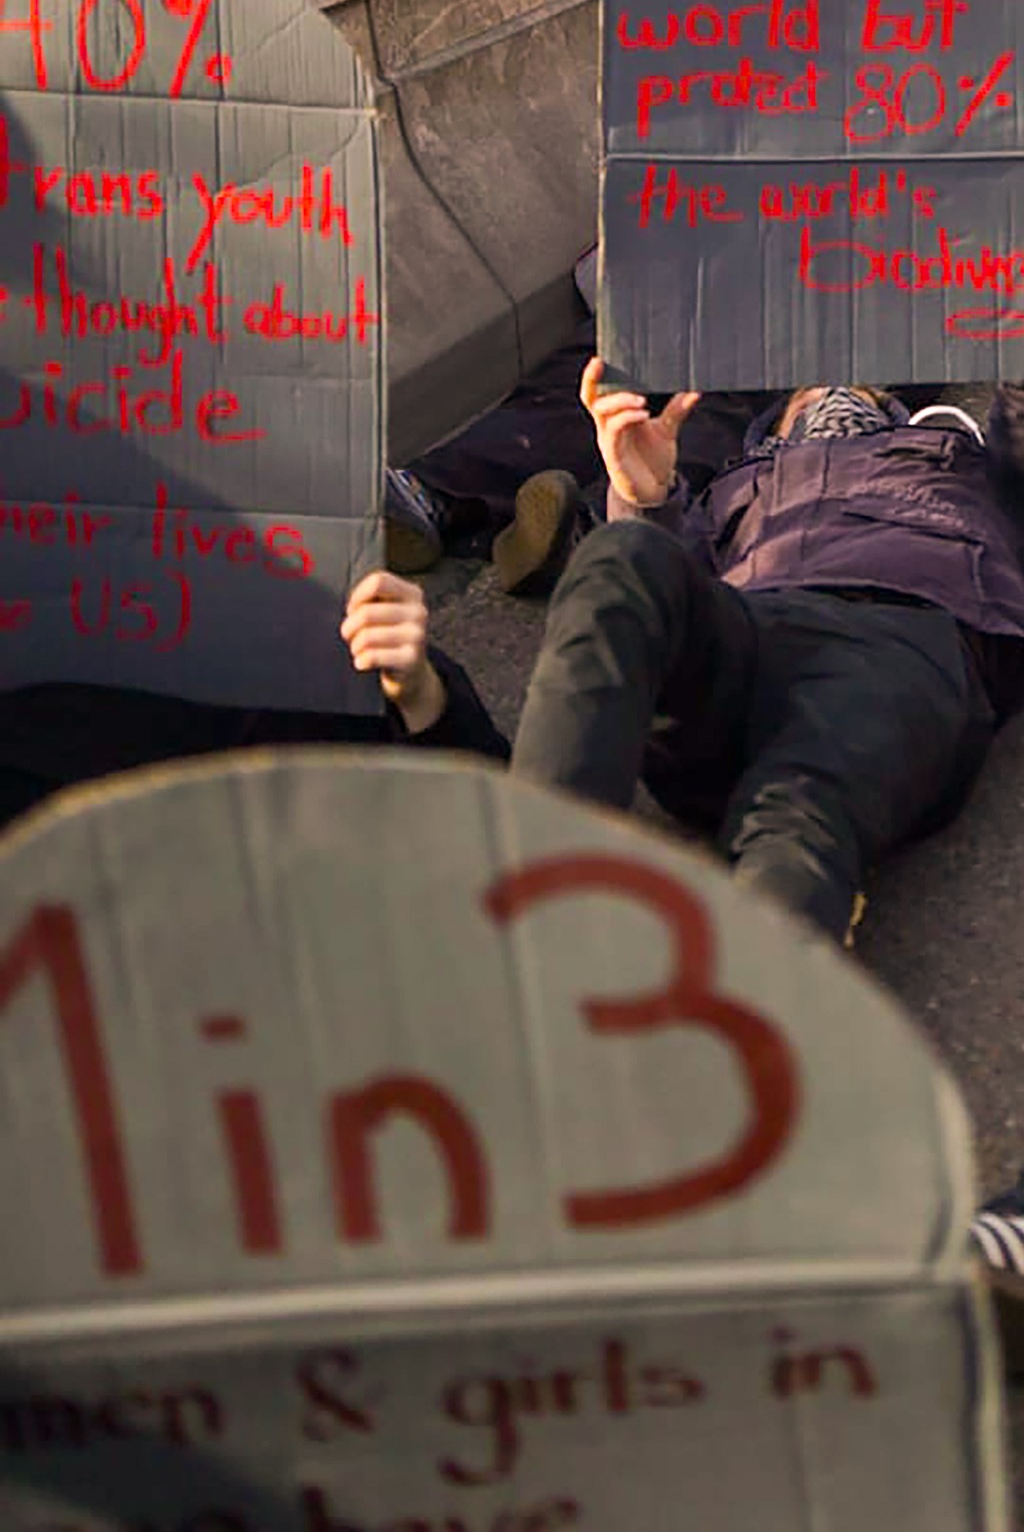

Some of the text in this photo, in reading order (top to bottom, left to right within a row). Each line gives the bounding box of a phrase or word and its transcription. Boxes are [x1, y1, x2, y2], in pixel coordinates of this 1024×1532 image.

[844, 48, 1013, 143] 80%
[185, 161, 354, 276] youth
[640, 166, 935, 228] the world's
[24, 241, 230, 364] thought
[242, 276, 384, 346] about
[0, 346, 268, 446] uicide
[150, 476, 318, 580] lives
[0, 854, 804, 1278] 1 in 3
[0, 1324, 882, 1486] men & girls in
